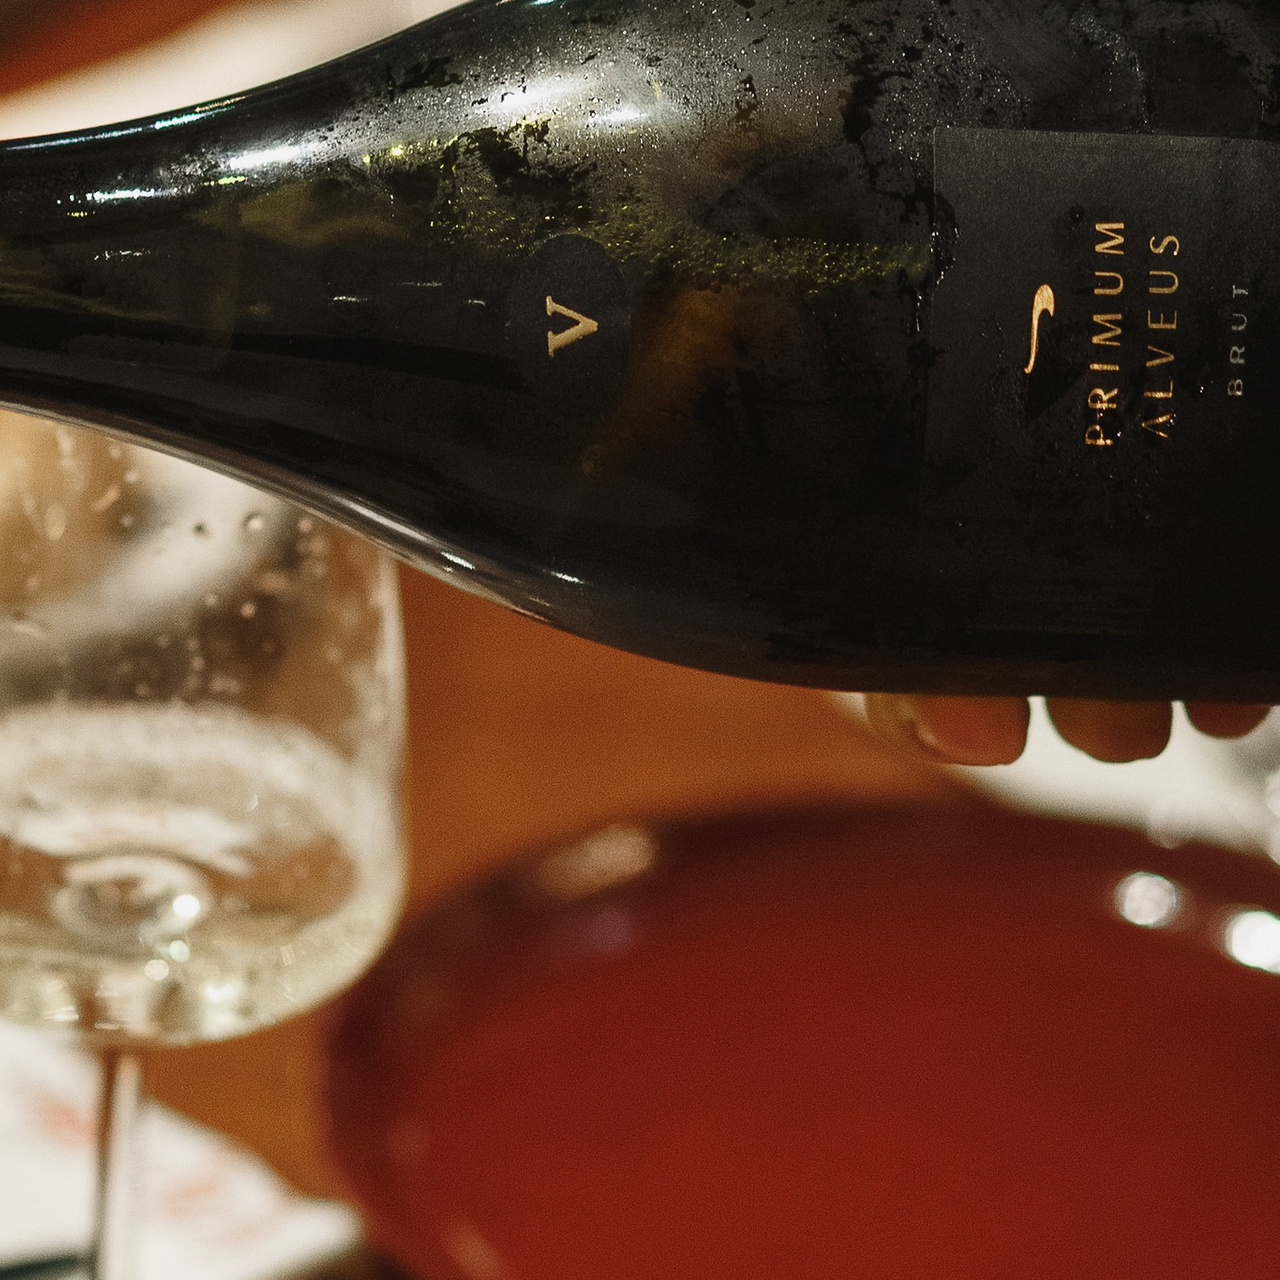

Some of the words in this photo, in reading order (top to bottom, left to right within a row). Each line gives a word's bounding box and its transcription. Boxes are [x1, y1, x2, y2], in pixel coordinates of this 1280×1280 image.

[546, 295, 599, 358] V
[1085, 222, 1125, 446] PRIMUM
[1141, 235, 1180, 438] ALVEUS
[1227, 284, 1249, 396] BRUT
